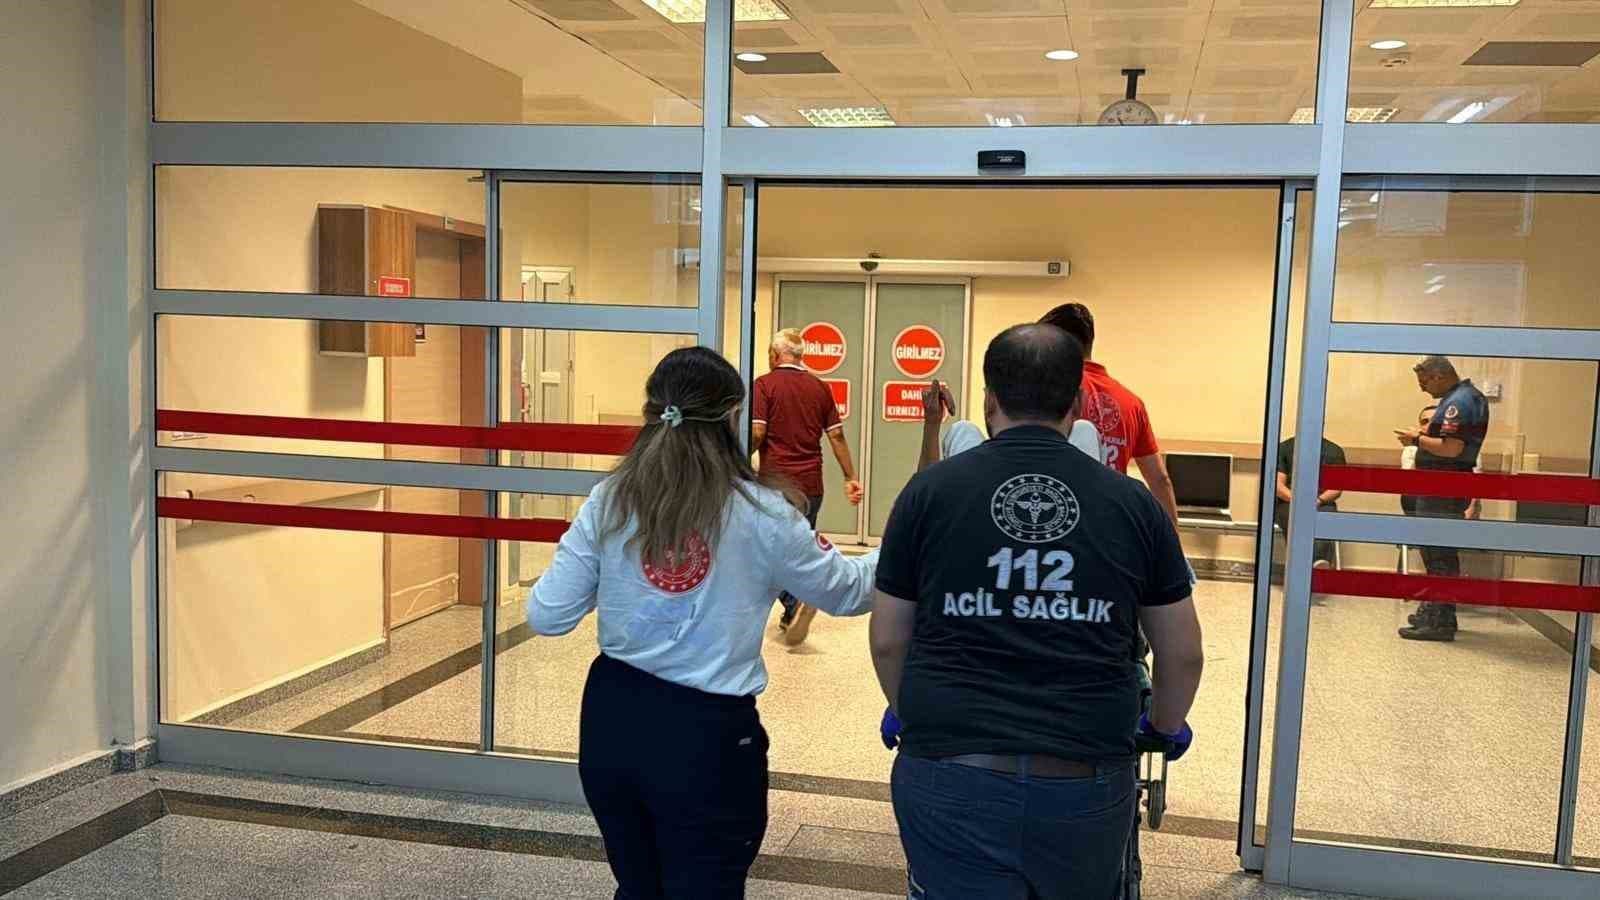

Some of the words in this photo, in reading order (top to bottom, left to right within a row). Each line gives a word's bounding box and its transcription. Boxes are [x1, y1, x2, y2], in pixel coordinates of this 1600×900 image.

[804, 340, 842, 356] İRİLMEZ
[896, 344, 942, 360] GİRİLMEZ
[901, 387, 923, 400] DAHİ
[887, 406, 920, 417] KIRMIZI
[987, 547, 1075, 591] 112
[942, 587, 1002, 617] ACİL
[1012, 592, 1115, 623] SAĞLIK
